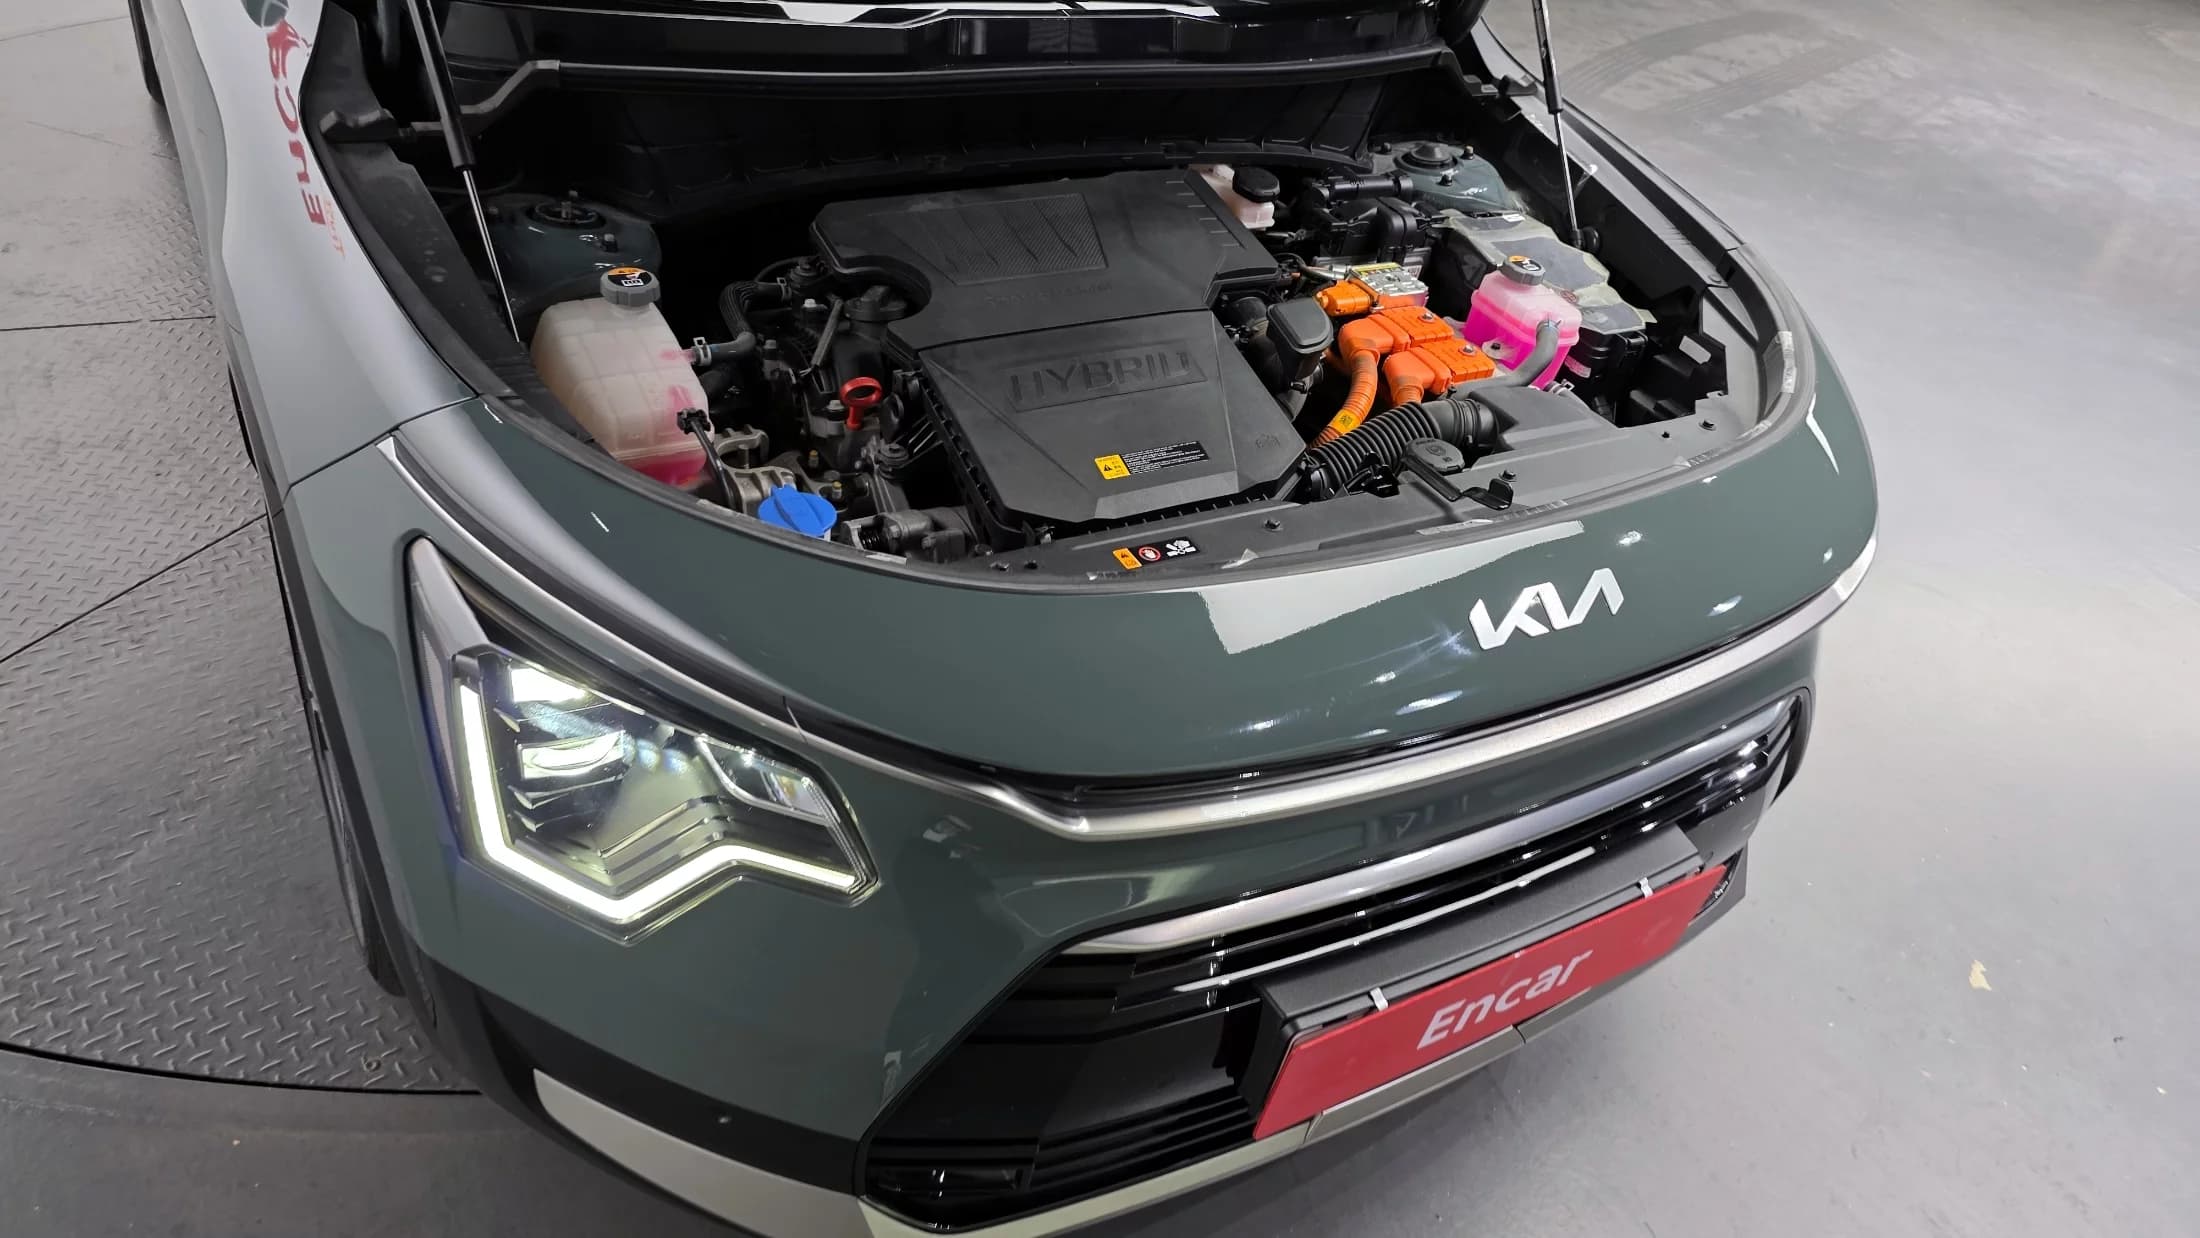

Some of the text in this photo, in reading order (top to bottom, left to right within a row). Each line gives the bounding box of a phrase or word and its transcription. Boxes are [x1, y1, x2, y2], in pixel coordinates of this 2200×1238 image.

[1010, 350, 1192, 401] HYBRID
[1469, 568, 1624, 650] KIA
[1417, 950, 1592, 1050] Encar
